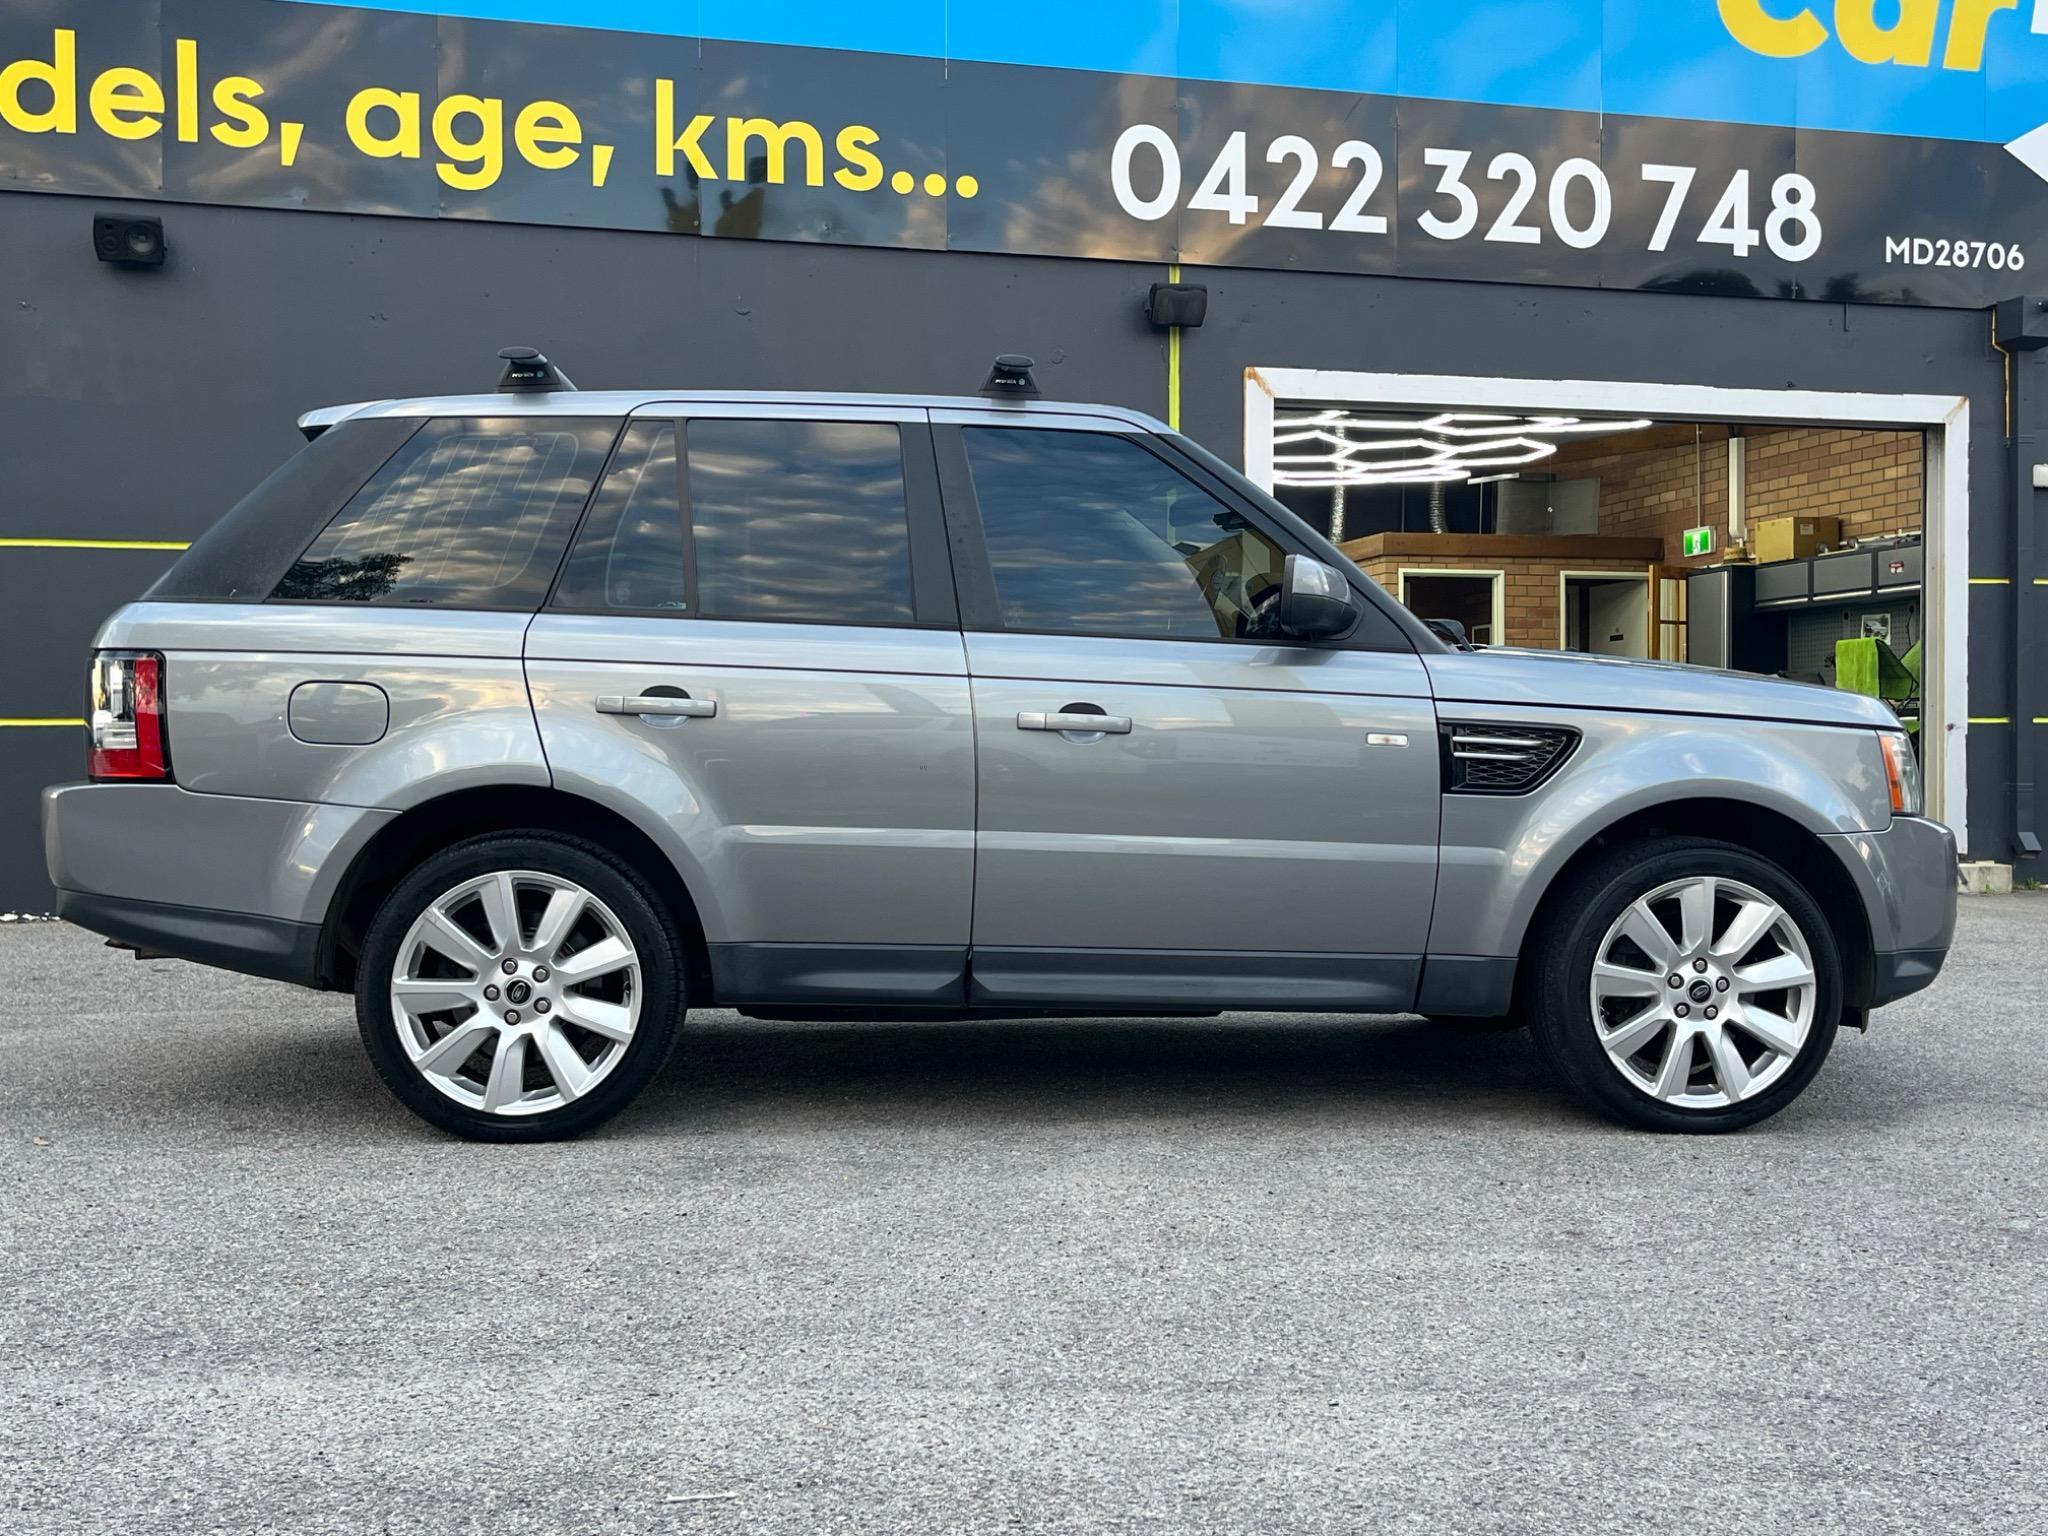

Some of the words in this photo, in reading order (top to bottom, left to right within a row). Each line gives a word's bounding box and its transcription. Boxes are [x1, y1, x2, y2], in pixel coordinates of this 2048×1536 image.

[0, 28, 304, 167] dels,
[345, 87, 615, 191] age,
[655, 78, 979, 198] kms...
[1110, 124, 1388, 235] 0422
[1417, 147, 1612, 249] 320
[1641, 163, 1822, 262] 748
[1885, 235, 2025, 271] MD28706
